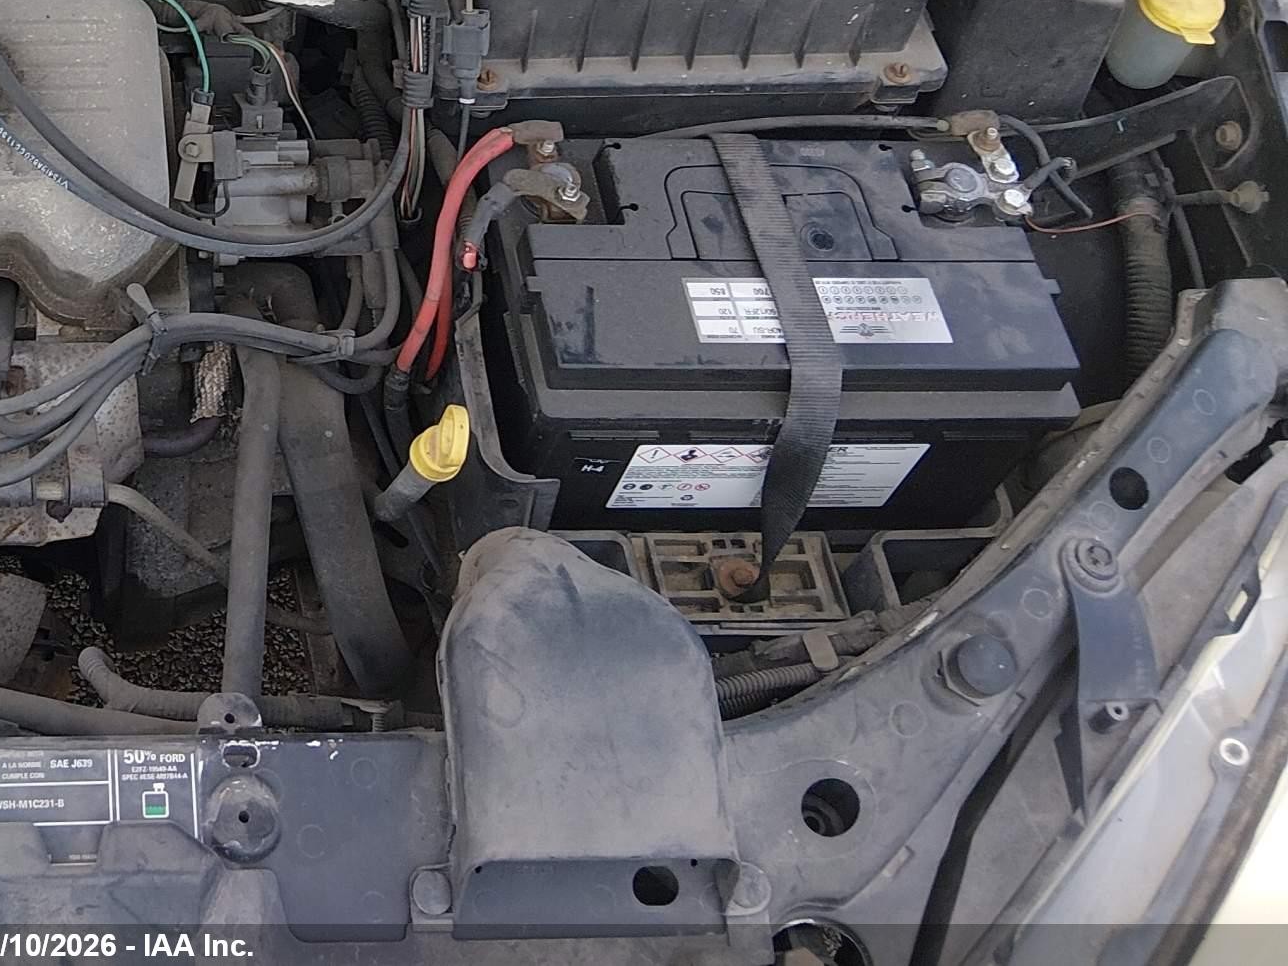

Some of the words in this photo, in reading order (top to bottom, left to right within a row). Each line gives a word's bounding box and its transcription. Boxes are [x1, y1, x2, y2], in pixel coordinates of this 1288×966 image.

[581, 464, 605, 473] H-4
[123, 749, 157, 764] 50%
[159, 753, 186, 763] FORD
[49, 759, 69, 769] SAE
[71, 759, 93, 768] J639
[121, 773, 138, 781] SPEC
